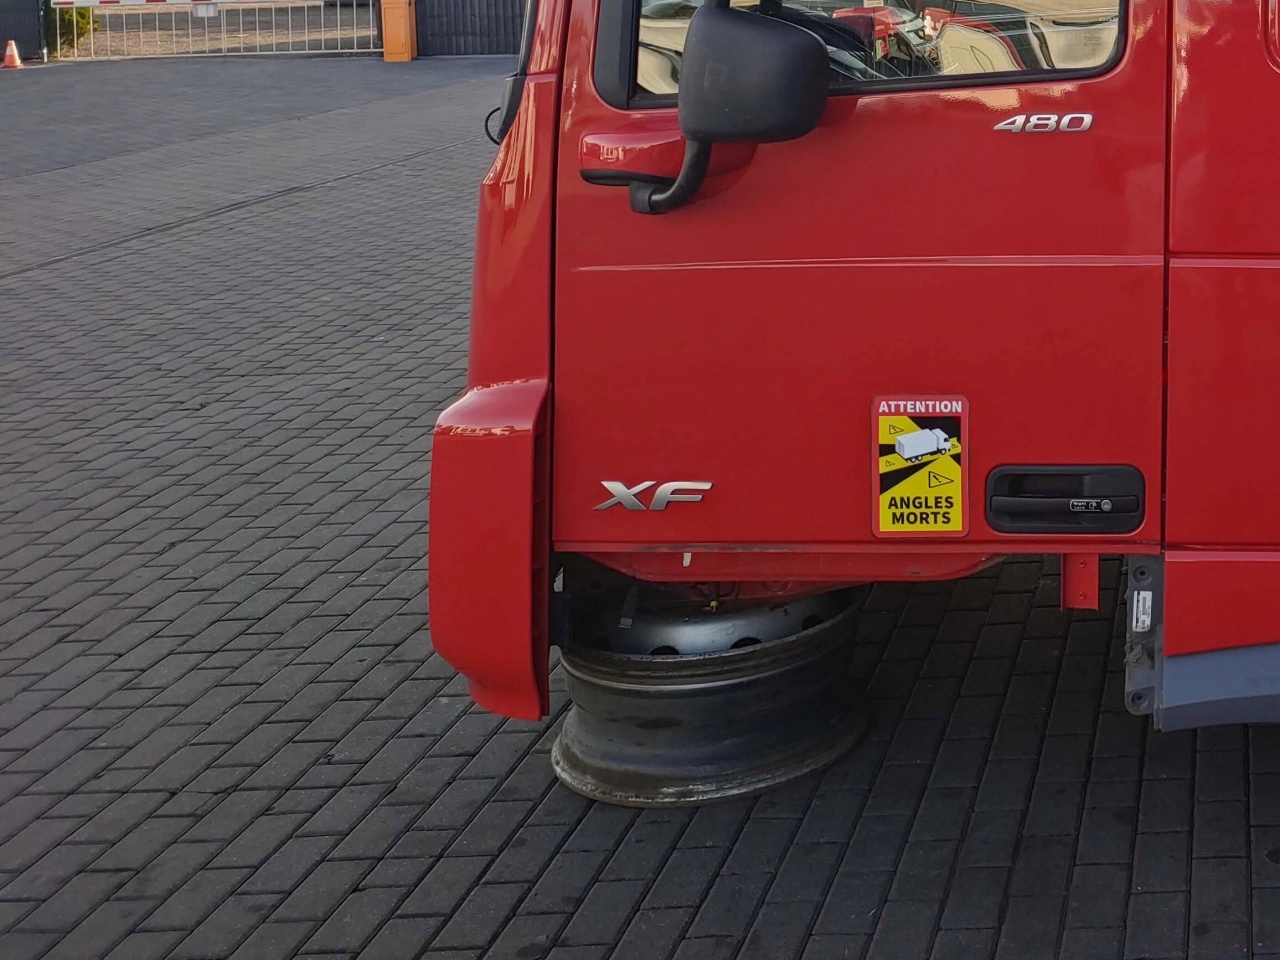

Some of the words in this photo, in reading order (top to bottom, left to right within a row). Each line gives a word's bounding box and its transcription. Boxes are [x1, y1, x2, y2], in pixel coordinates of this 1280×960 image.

[993, 113, 1093, 133] 480
[878, 400, 962, 413] ATTENTION
[592, 480, 713, 511] XF
[887, 496, 955, 510] ANGLES
[891, 511, 952, 525] MORTS
